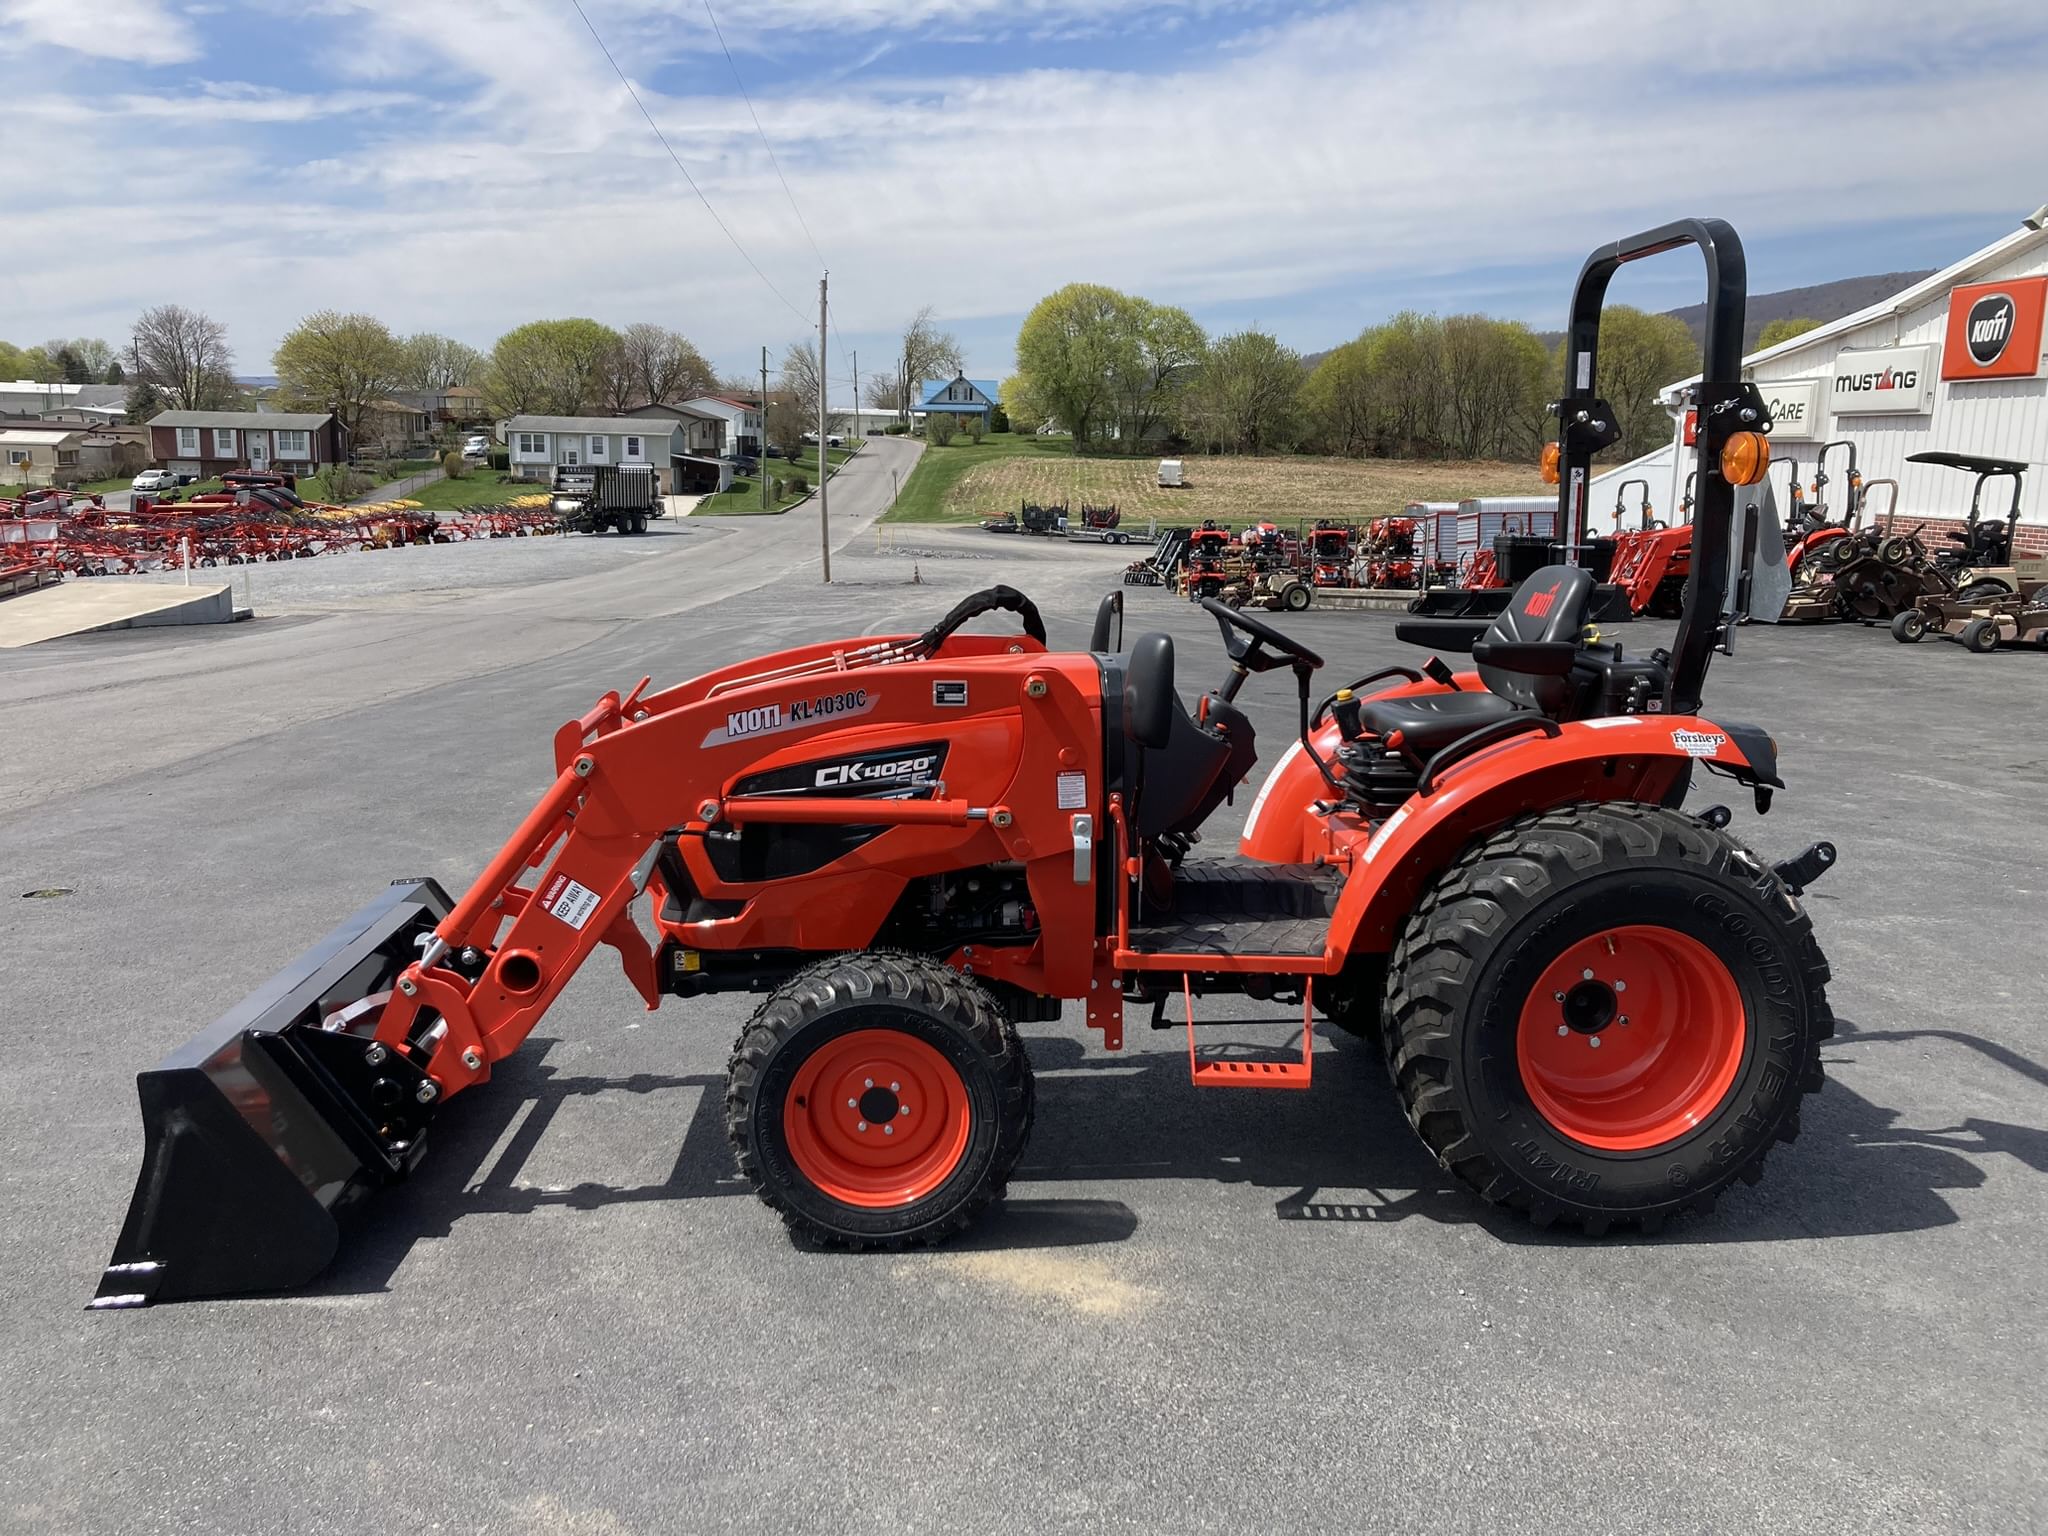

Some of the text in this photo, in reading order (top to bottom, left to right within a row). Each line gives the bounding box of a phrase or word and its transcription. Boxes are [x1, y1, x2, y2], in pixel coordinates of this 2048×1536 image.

[1970, 306, 2008, 343] KIOTI
[1836, 366, 1917, 393] MUSTANG
[1767, 398, 1805, 420] CARE
[727, 689, 867, 736] KIOTI KL4030C
[1674, 732, 1725, 745] Forsheys
[555, 884, 584, 918] KEEP AWAY
[1695, 893, 1796, 1165] GOODYEAR
